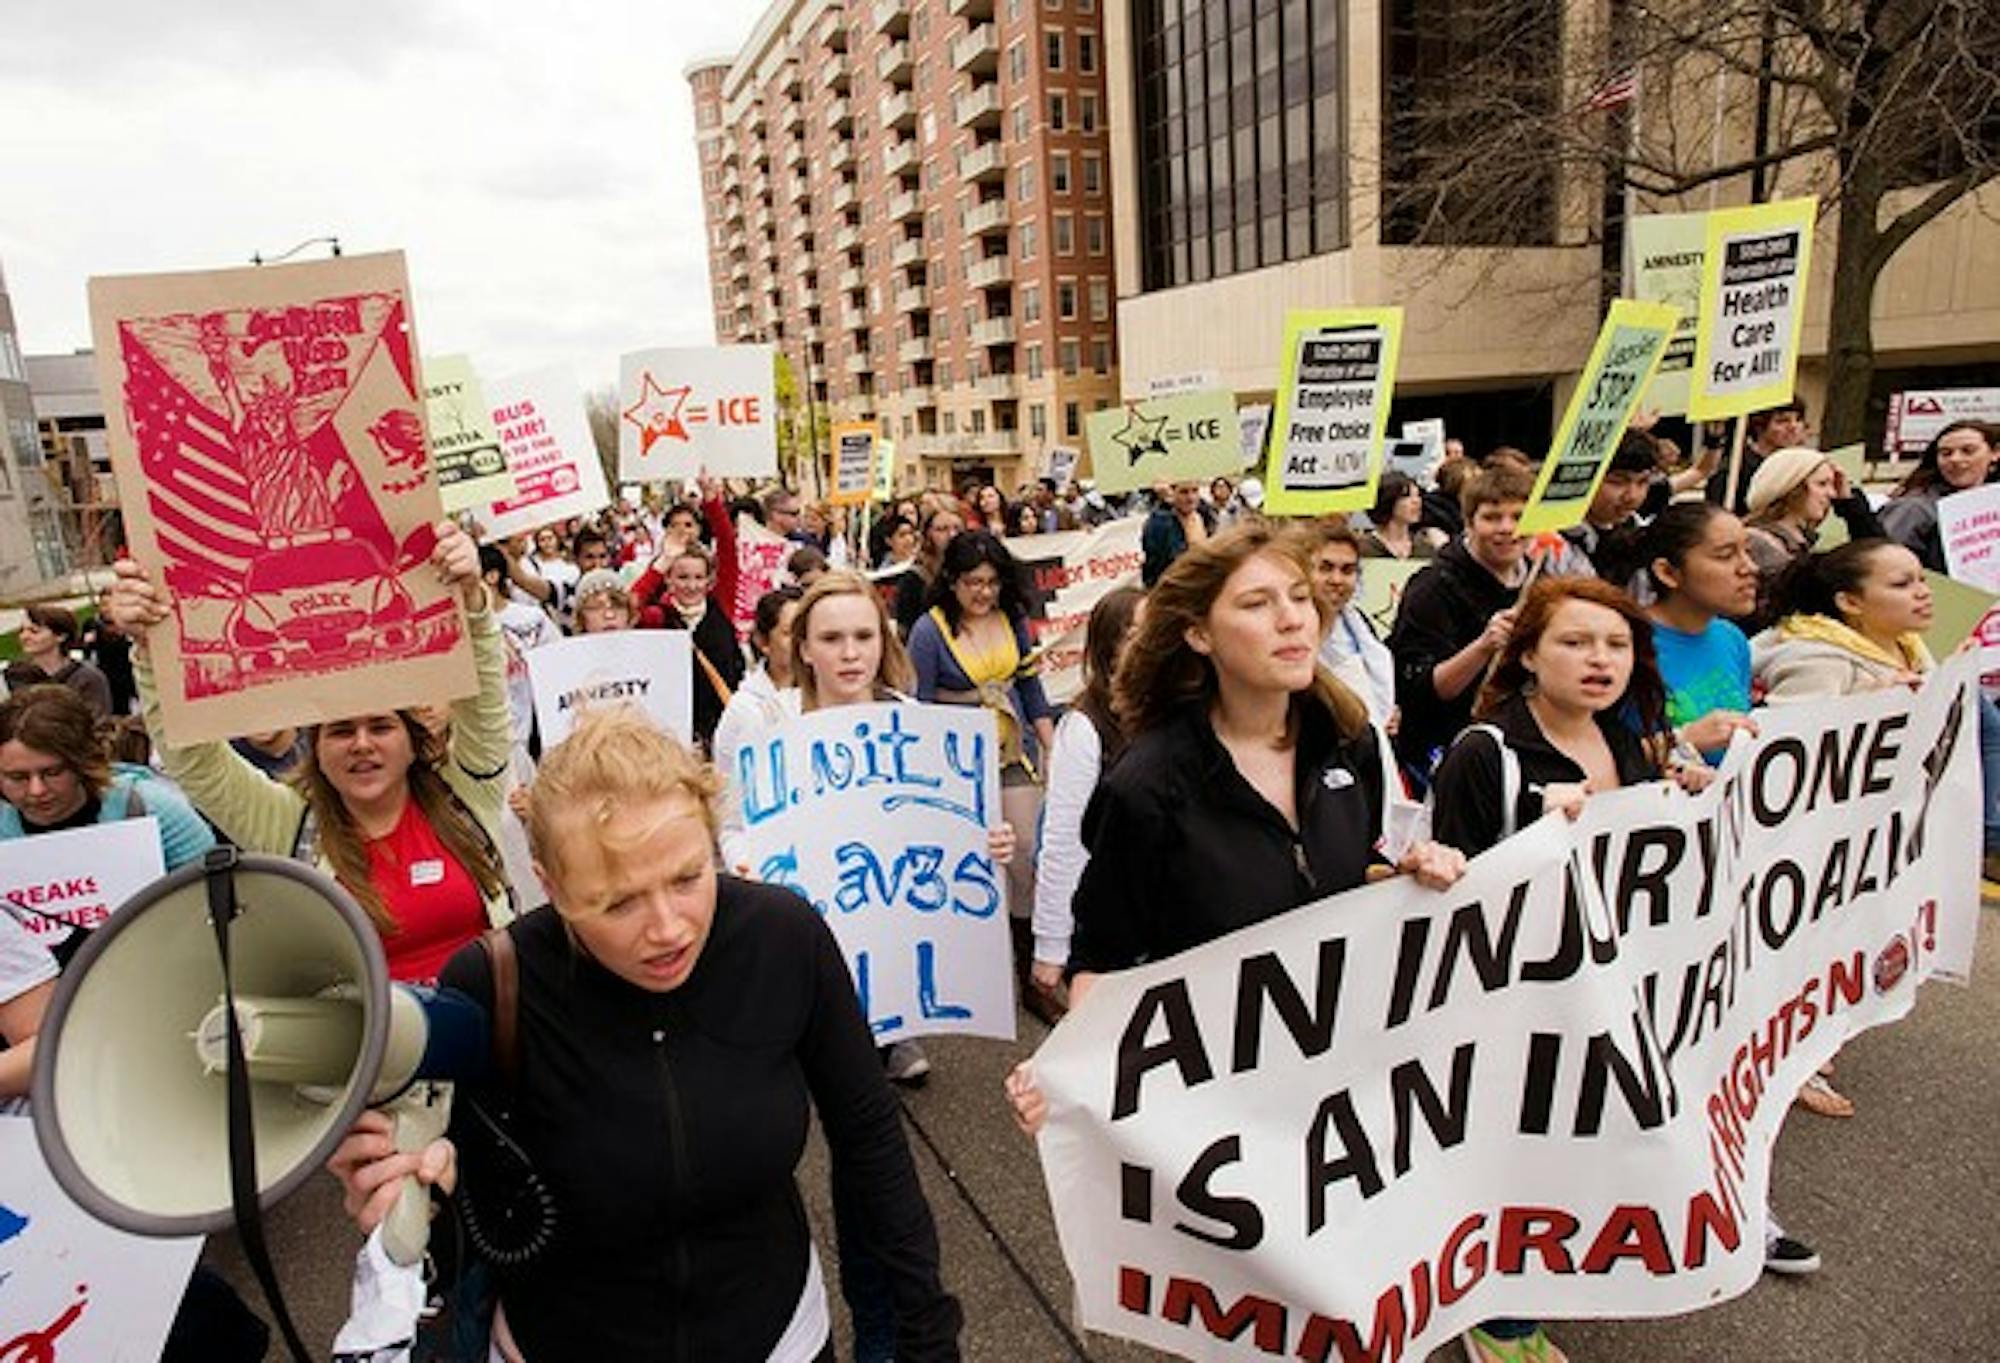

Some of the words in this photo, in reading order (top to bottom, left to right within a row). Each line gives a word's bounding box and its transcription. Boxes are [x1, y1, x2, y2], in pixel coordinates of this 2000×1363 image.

[1723, 283, 1788, 317] Health
[1731, 321, 1775, 347] Care
[1713, 361, 1745, 383] for
[716, 397, 761, 426] ICE
[1297, 387, 1373, 411] Employee
[1187, 418, 1221, 441] ICE
[1289, 423, 1325, 443] Free
[1329, 422, 1370, 441] Choice
[1287, 455, 1318, 475] Act
[1111, 936, 1346, 1121] AN
[1385, 815, 1719, 1030] INJURY
[1751, 712, 1909, 828] ONE
[856, 940, 973, 1034] LL
[1120, 1134, 1265, 1251] IS
[1306, 1042, 1475, 1237] AN
[1518, 926, 1738, 1138] INUR
[1118, 1172, 1747, 1363] IMMIGRAN
